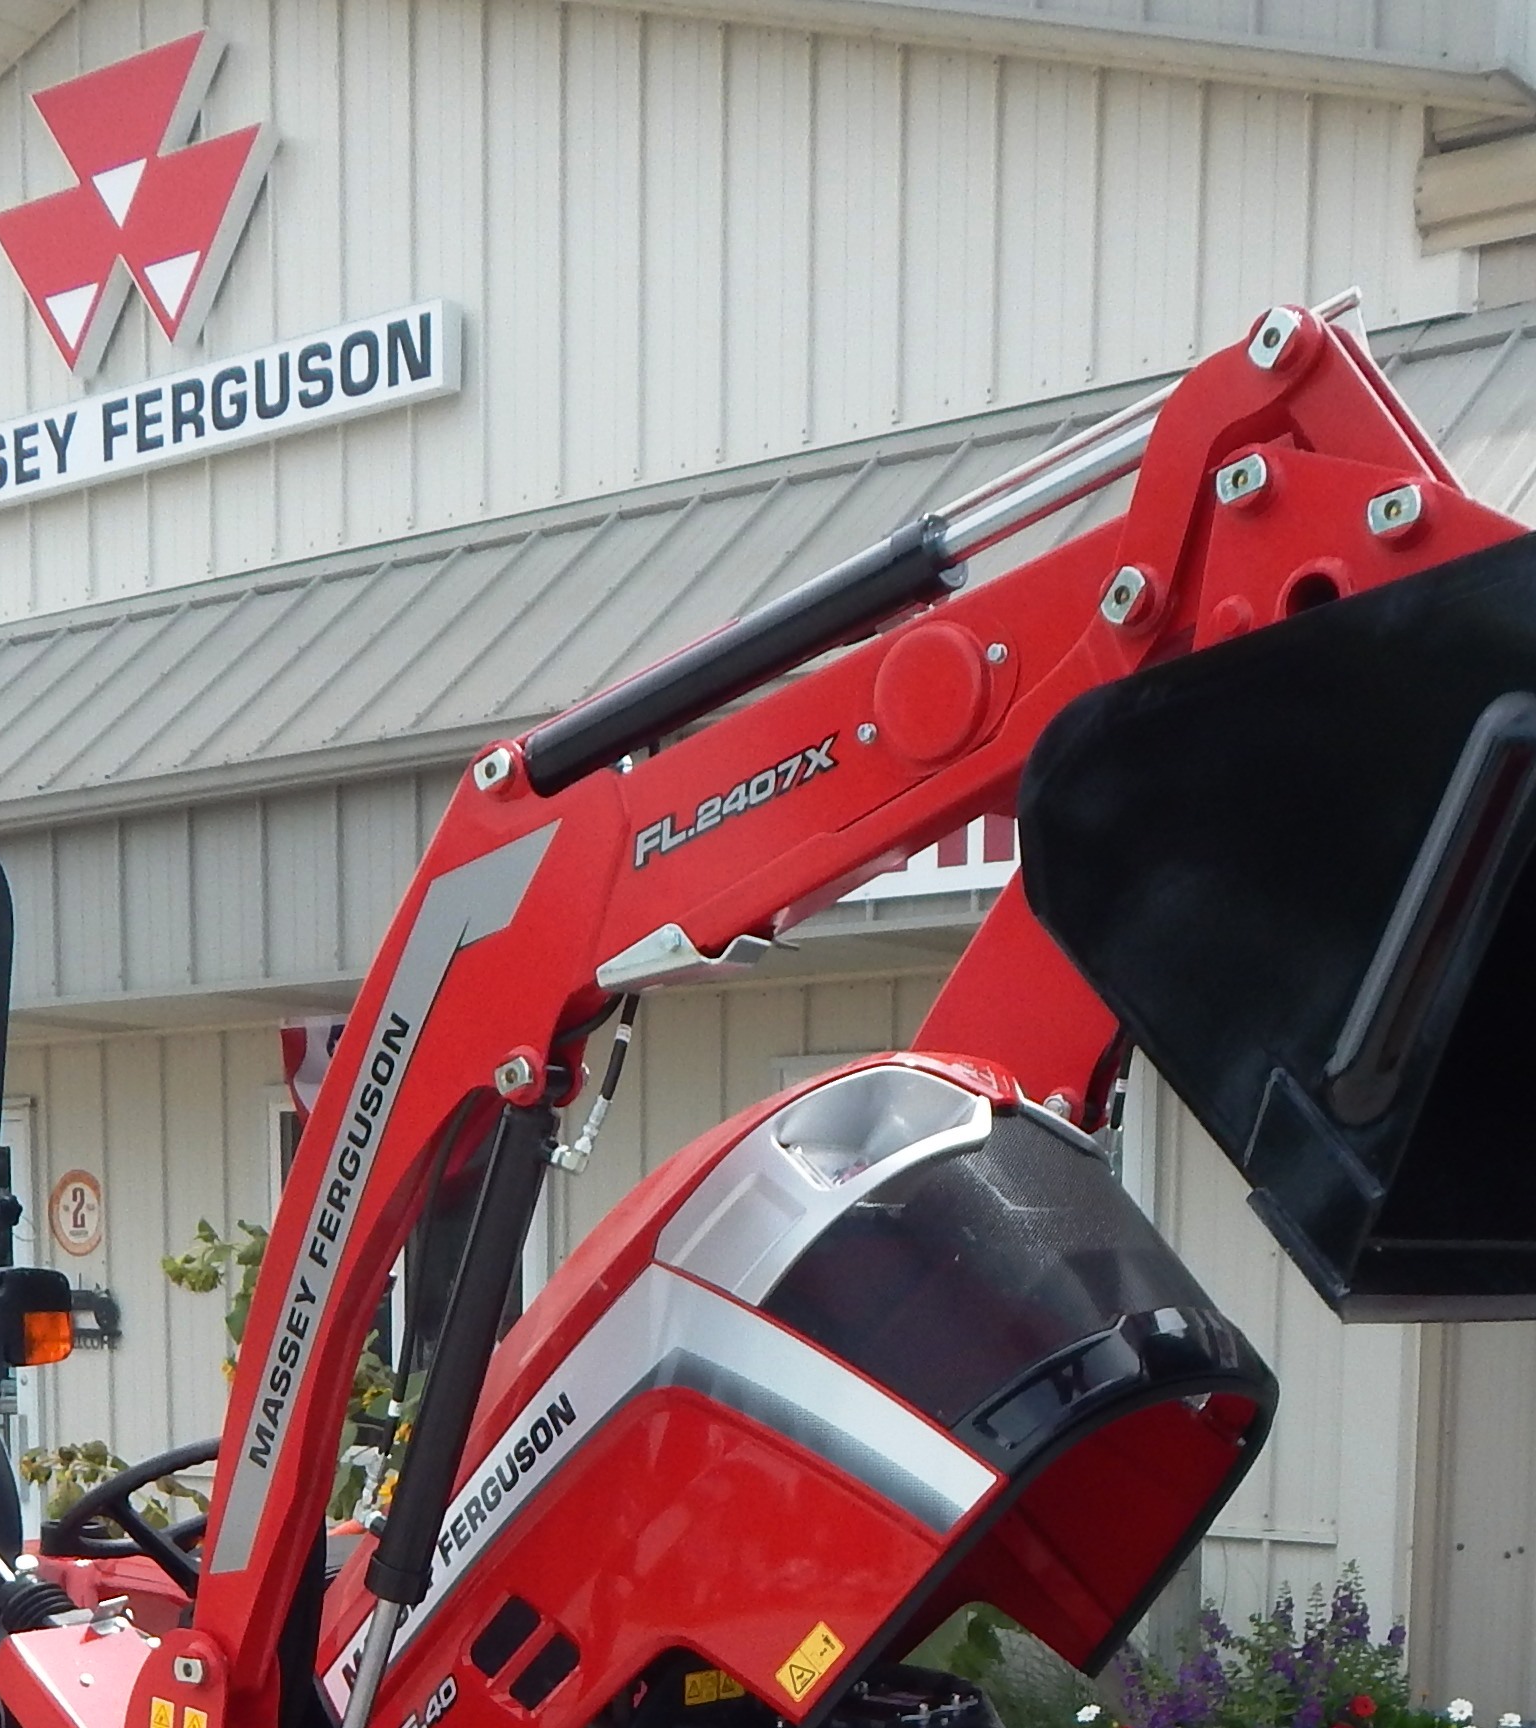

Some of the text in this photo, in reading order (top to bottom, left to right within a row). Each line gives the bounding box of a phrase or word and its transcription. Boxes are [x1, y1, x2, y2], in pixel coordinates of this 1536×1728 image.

[102, 312, 434, 462] FERGUSON
[634, 734, 838, 868] FL.2407X
[72, 1187, 86, 1229] 2
[247, 1011, 411, 1470] MASSEY FERGUSON
[436, 1391, 577, 1567] FERGUSON
